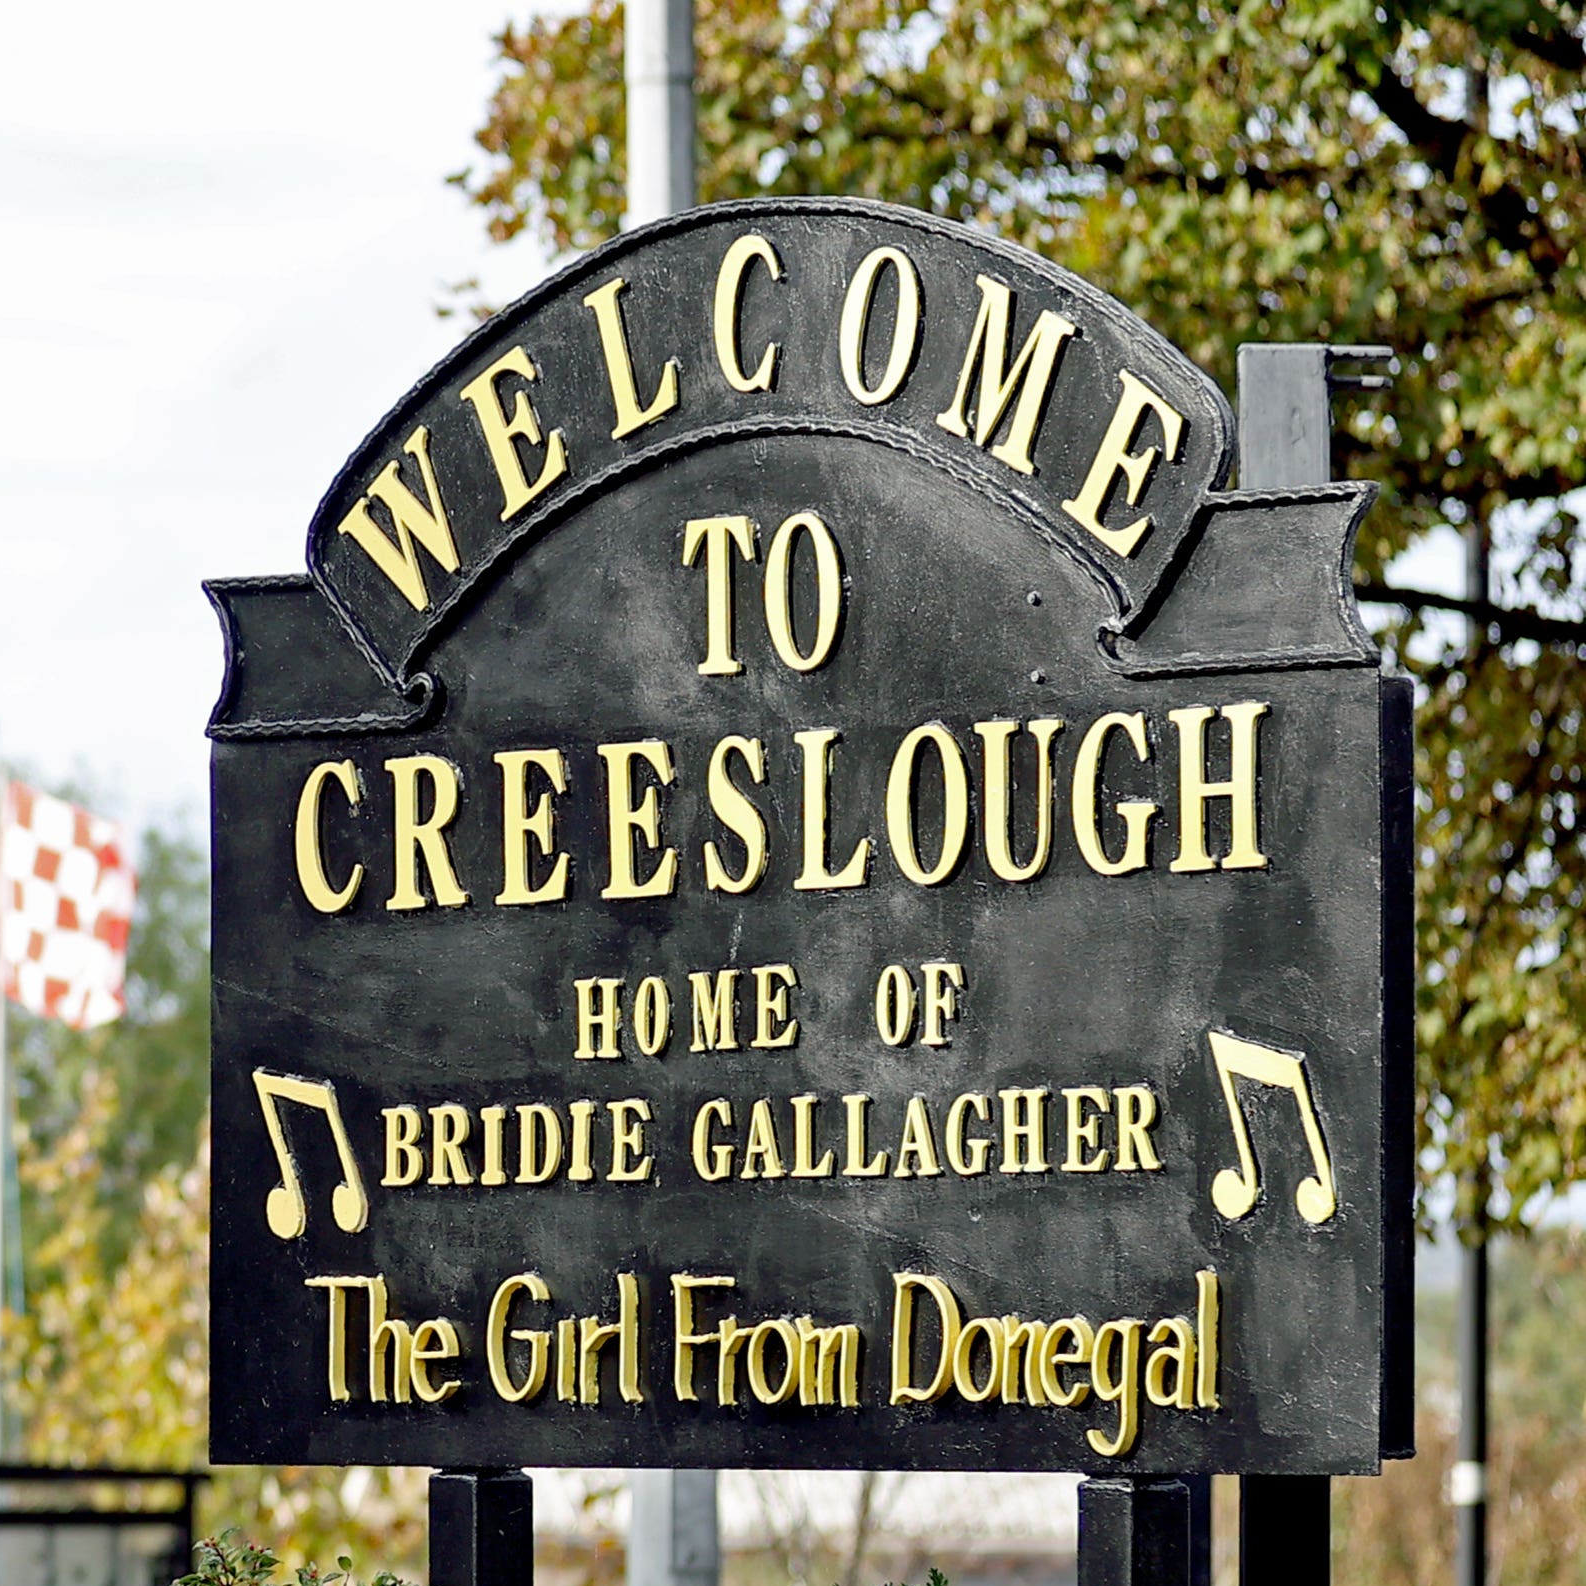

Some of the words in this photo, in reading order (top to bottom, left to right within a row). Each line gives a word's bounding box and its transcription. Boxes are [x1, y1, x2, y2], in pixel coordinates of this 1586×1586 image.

[336, 233, 1184, 613] WELCOME
[681, 512, 841, 676] TO
[294, 703, 1268, 914] CREESLOUGH
[573, 964, 797, 1060] HOME
[875, 962, 964, 1046] OF
[379, 1099, 652, 1187] BRIDIE
[691, 1086, 1162, 1182] GALLAGHER
[304, 1273, 461, 1404] The
[485, 1272, 645, 1405] Girl
[669, 1272, 860, 1407] From
[888, 1269, 1221, 1457] Donegal
